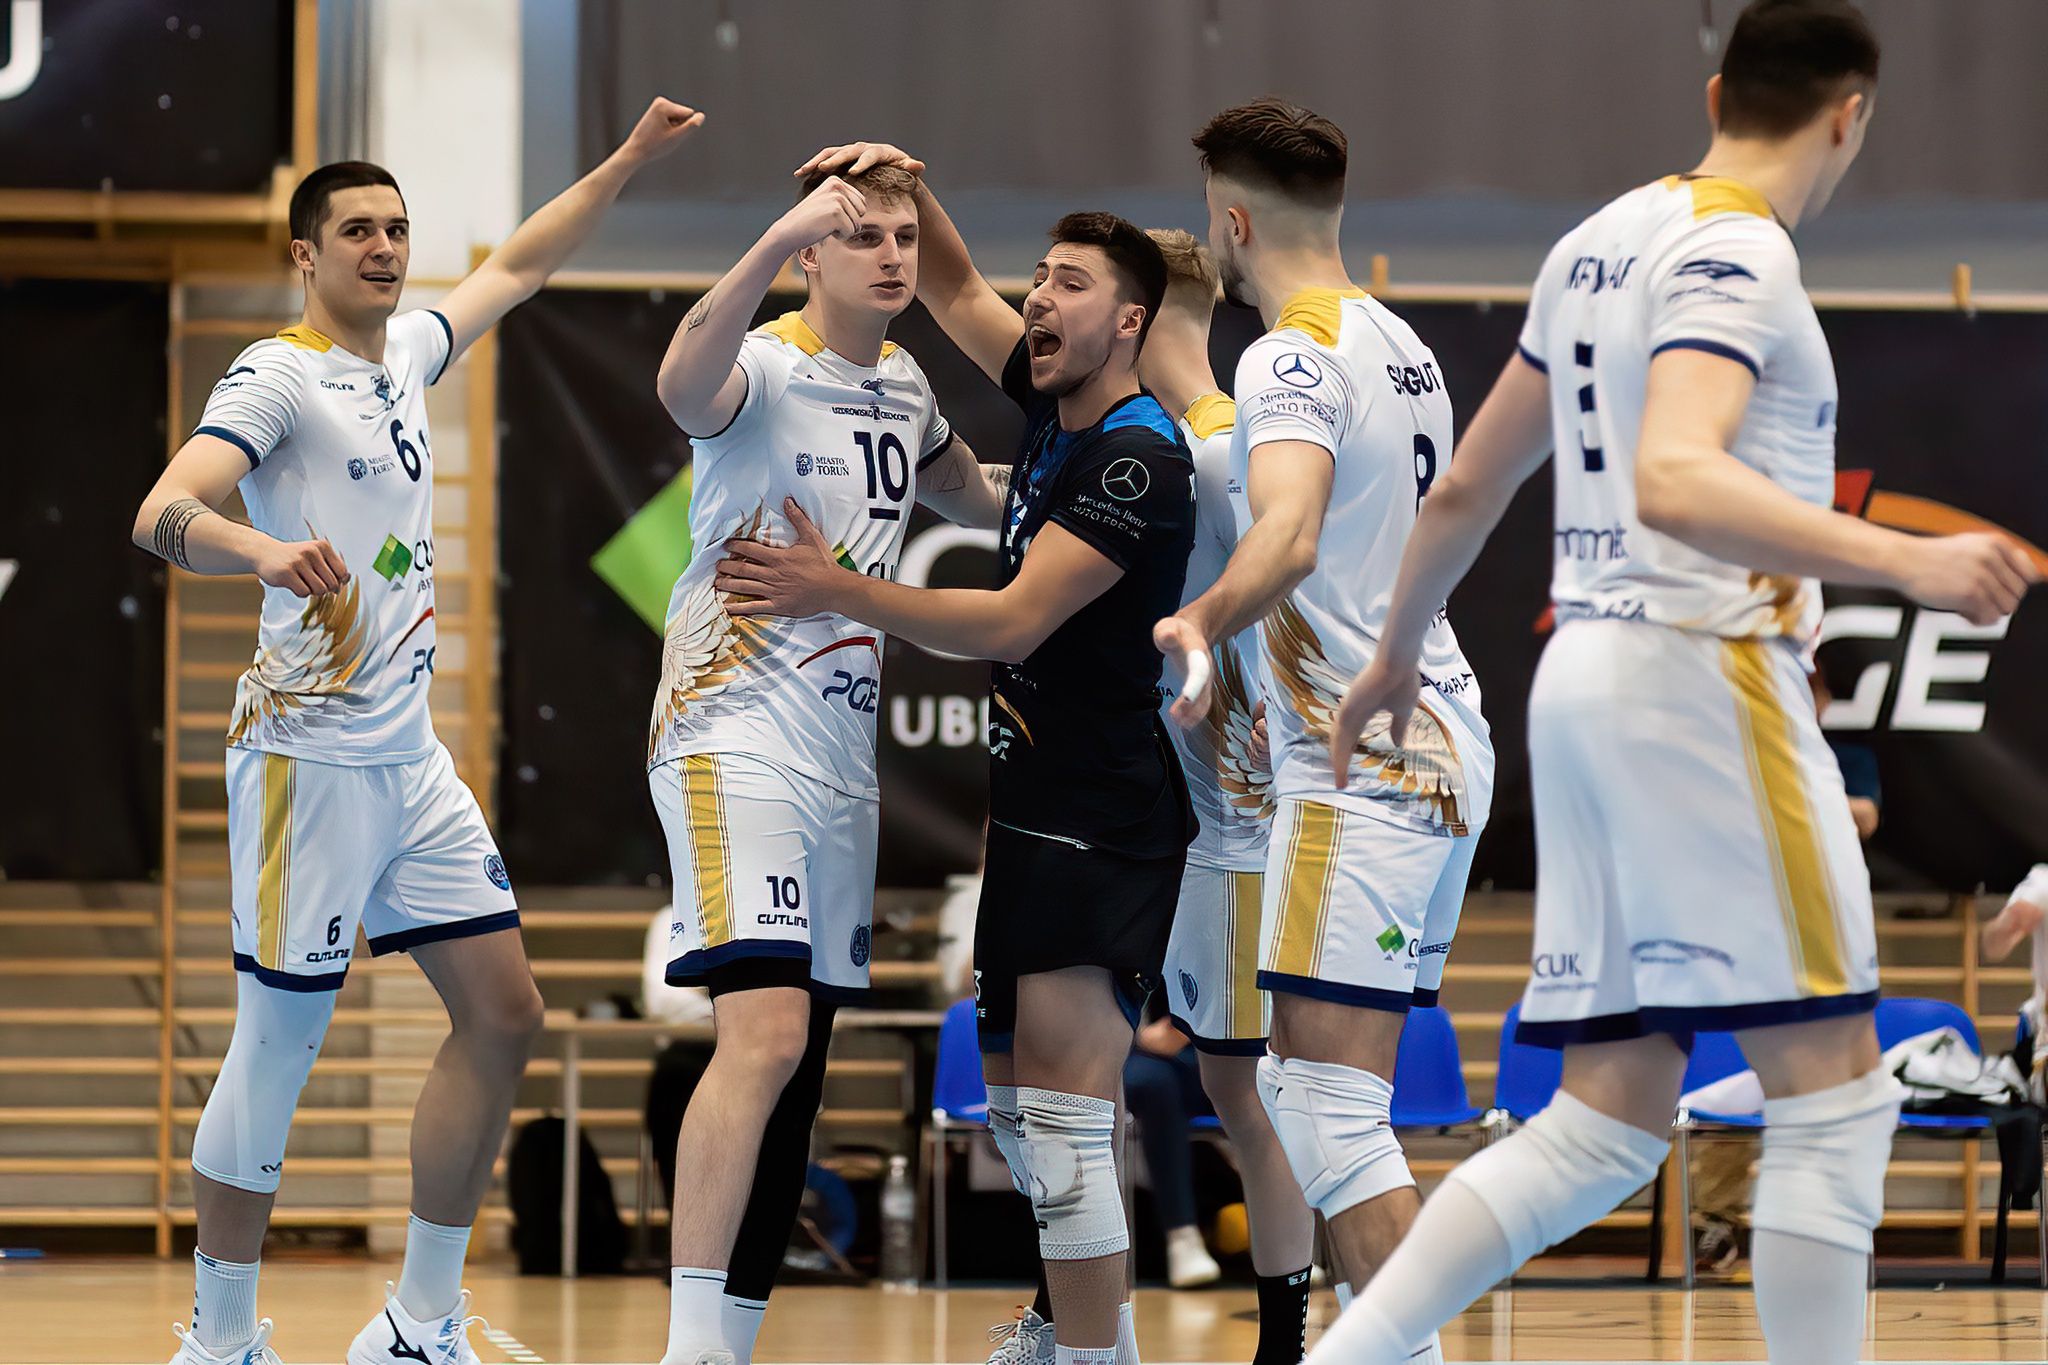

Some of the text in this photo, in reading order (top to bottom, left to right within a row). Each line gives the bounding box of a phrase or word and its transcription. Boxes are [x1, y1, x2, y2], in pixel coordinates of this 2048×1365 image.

[390, 419, 421, 482] 6
[815, 456, 845, 465] MIASTO
[853, 431, 909, 503] 10
[822, 669, 878, 714] PGE
[766, 875, 801, 911] 10
[327, 914, 342, 947] 6
[757, 913, 808, 929] CUTLINE
[1534, 953, 1582, 978] CUK
